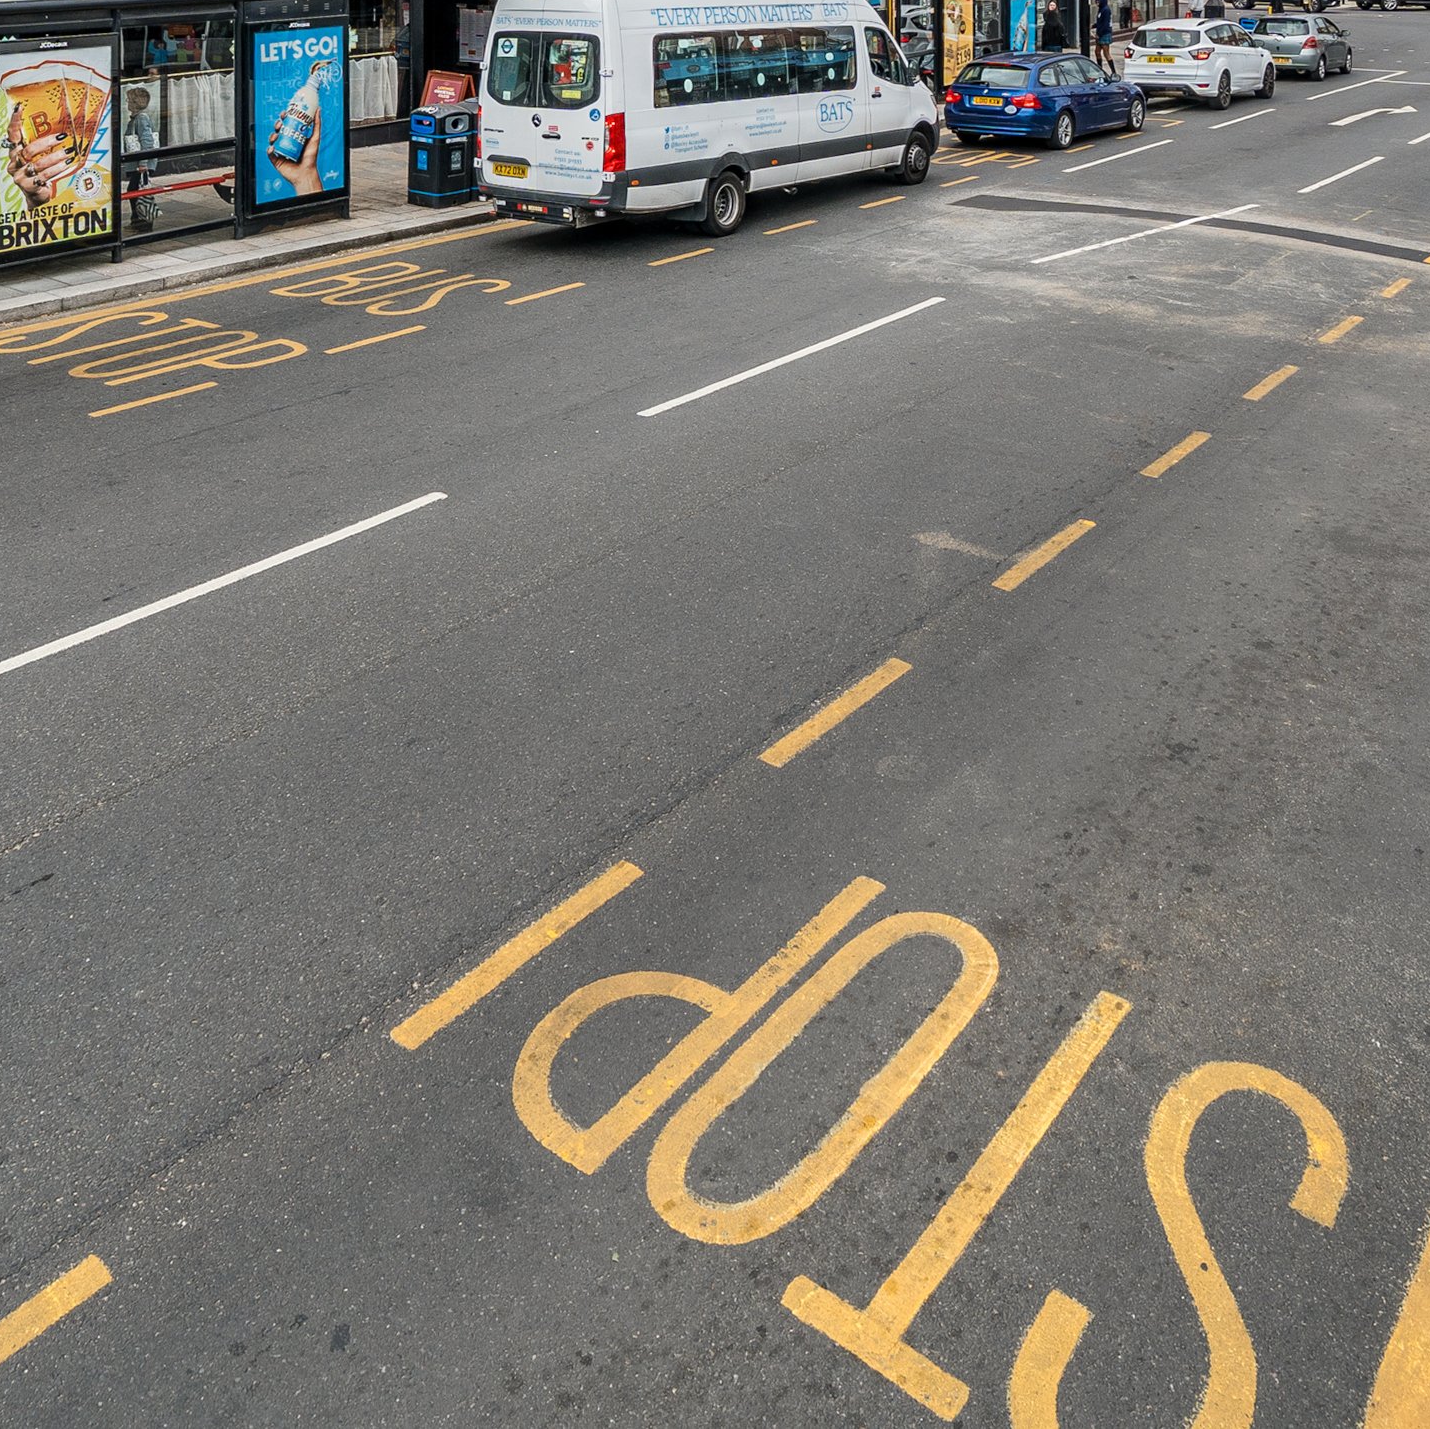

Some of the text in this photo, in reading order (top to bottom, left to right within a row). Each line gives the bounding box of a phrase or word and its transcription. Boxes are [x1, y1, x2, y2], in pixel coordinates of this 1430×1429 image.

[496, 15, 511, 25] BATS
[536, 17, 563, 26] PERSON
[704, 6, 756, 24] PERSON
[822, 3, 847, 17] BATS
[39, 41, 68, 49] JCDecaux
[260, 35, 338, 63] LET'S GO!
[956, 48, 971, 66] £1.99
[820, 101, 853, 122] BATS
[30, 111, 52, 139] B
[280, 124, 306, 145] COFFEE
[495, 163, 511, 176] KX72
[83, 177, 94, 191] B
[20, 210, 27, 221] A
[28, 205, 59, 220] TASTE
[61, 202, 74, 213] OF
[269, 261, 512, 316] BUS
[512, 875, 1349, 1429] STOP
